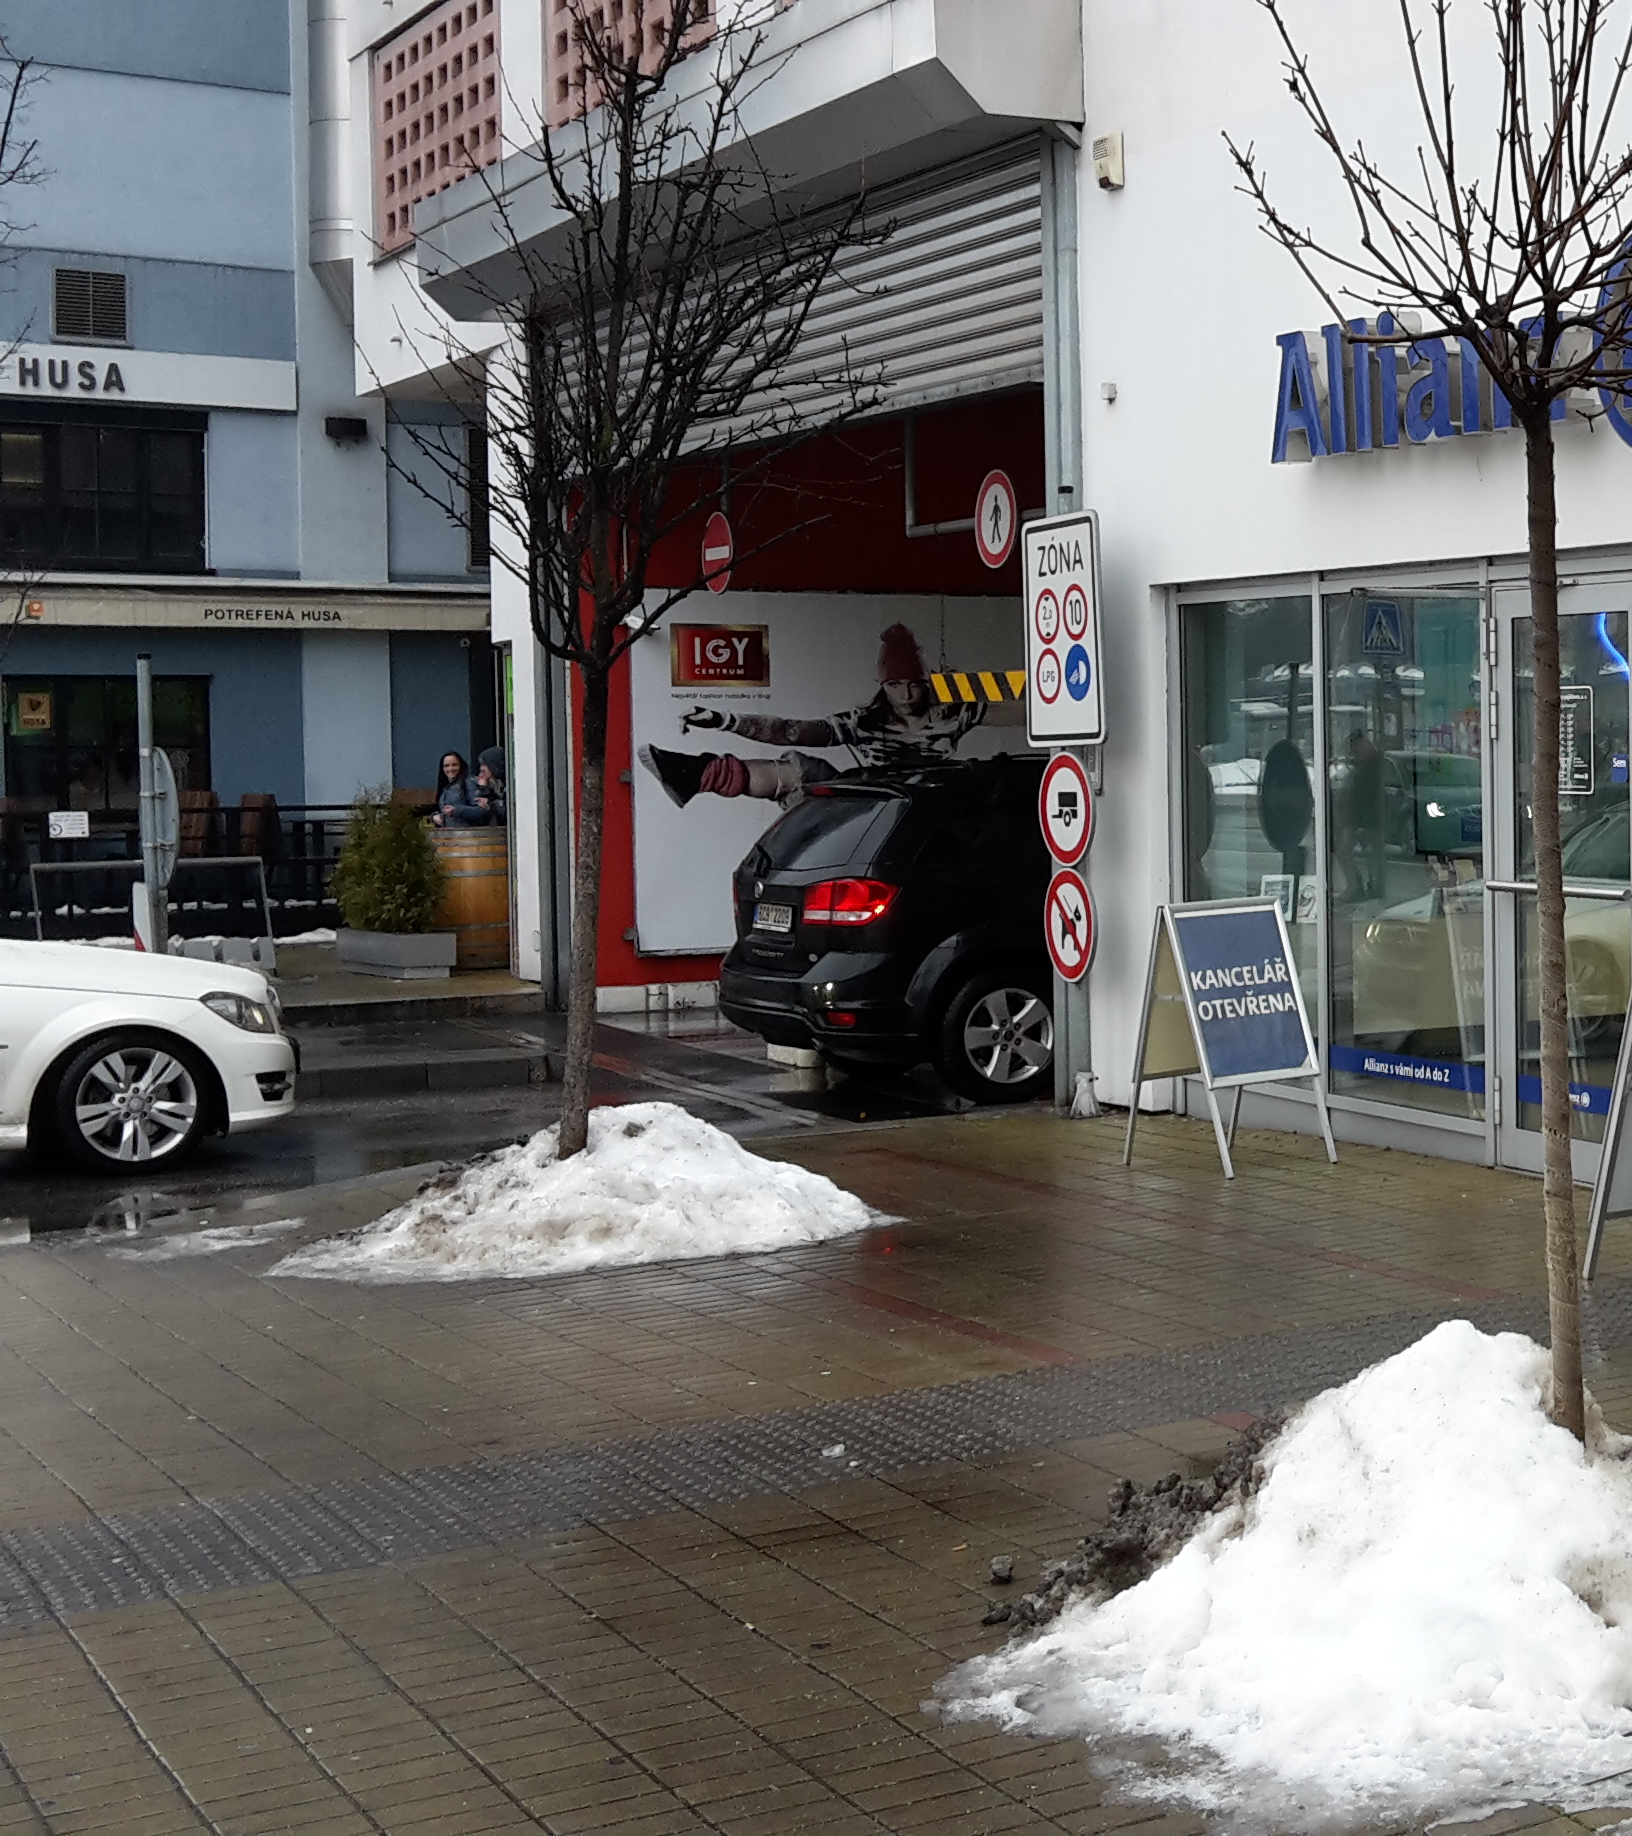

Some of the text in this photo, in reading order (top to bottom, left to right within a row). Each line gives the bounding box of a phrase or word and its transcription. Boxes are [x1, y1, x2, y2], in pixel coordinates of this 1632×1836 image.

[18, 356, 126, 393] HUSA
[1037, 536, 1084, 578] ZÓNA
[203, 606, 342, 622] POTREFENÁ HUSA
[1069, 598, 1082, 626] 10
[694, 636, 749, 666] IGY
[694, 667, 745, 676] CENTRUM
[1190, 956, 1289, 991] KANCELÁŘ
[1198, 989, 1297, 1021] OTEVŘENA
[1364, 1057, 1389, 1073] Allianz
[1394, 1063, 1413, 1077] vámi
[1414, 1065, 1424, 1079] od
[1425, 1067, 1431, 1080] A
[1432, 1067, 1443, 1081] do
[1443, 1069, 1450, 1082] Z
